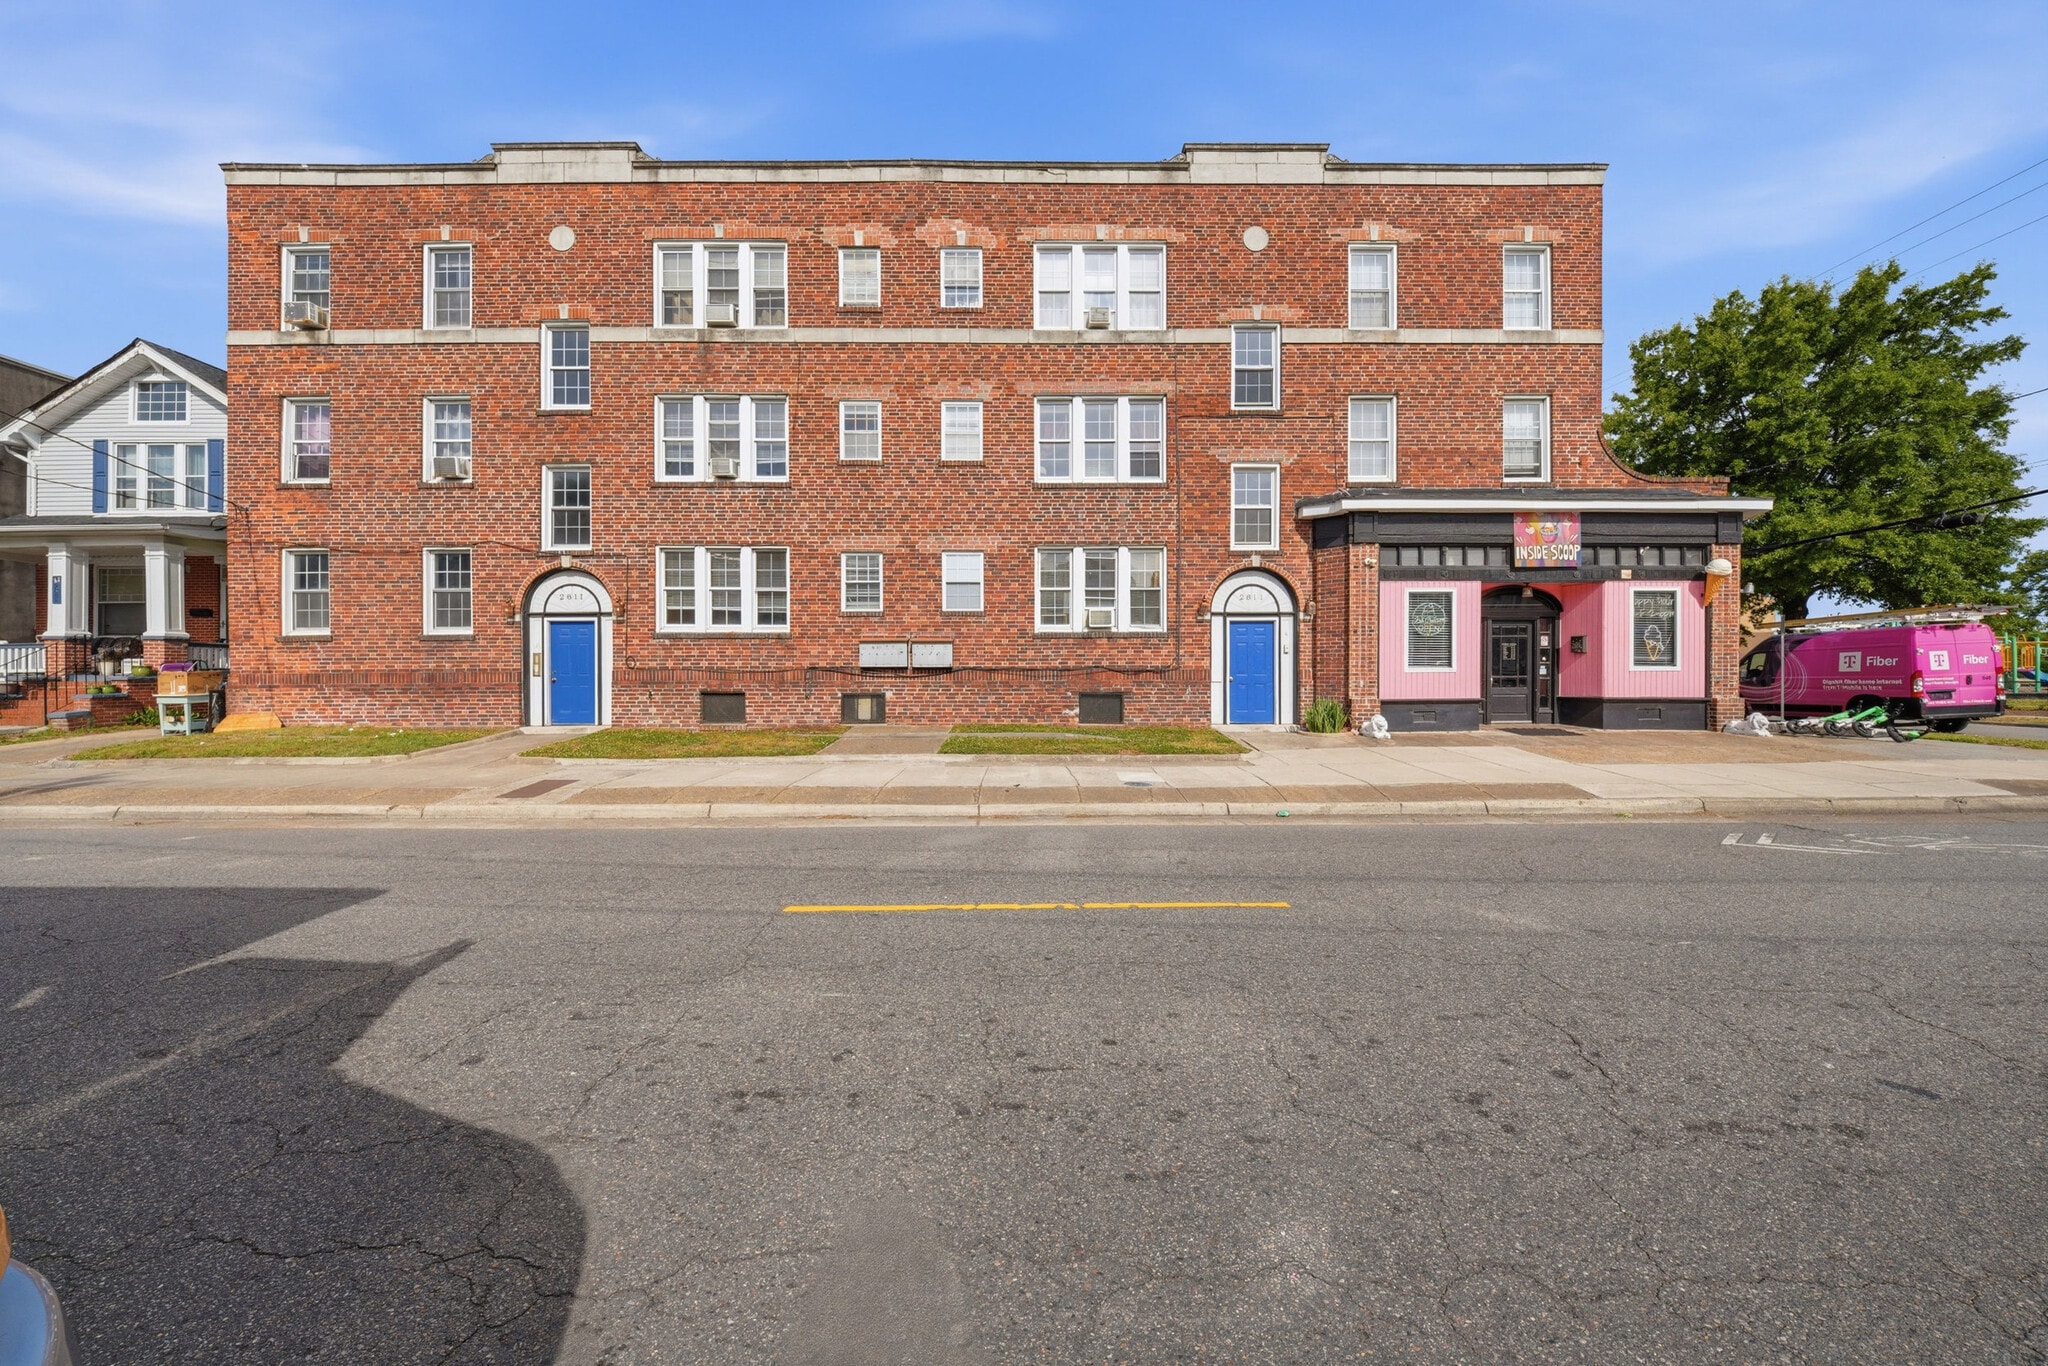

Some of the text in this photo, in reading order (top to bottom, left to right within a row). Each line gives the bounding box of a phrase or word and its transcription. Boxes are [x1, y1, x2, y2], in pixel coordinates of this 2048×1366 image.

[1516, 544, 1581, 561] INSIDE SCOOP
[1866, 655, 1899, 667] Fiber
[1962, 654, 1989, 665] Fiber
